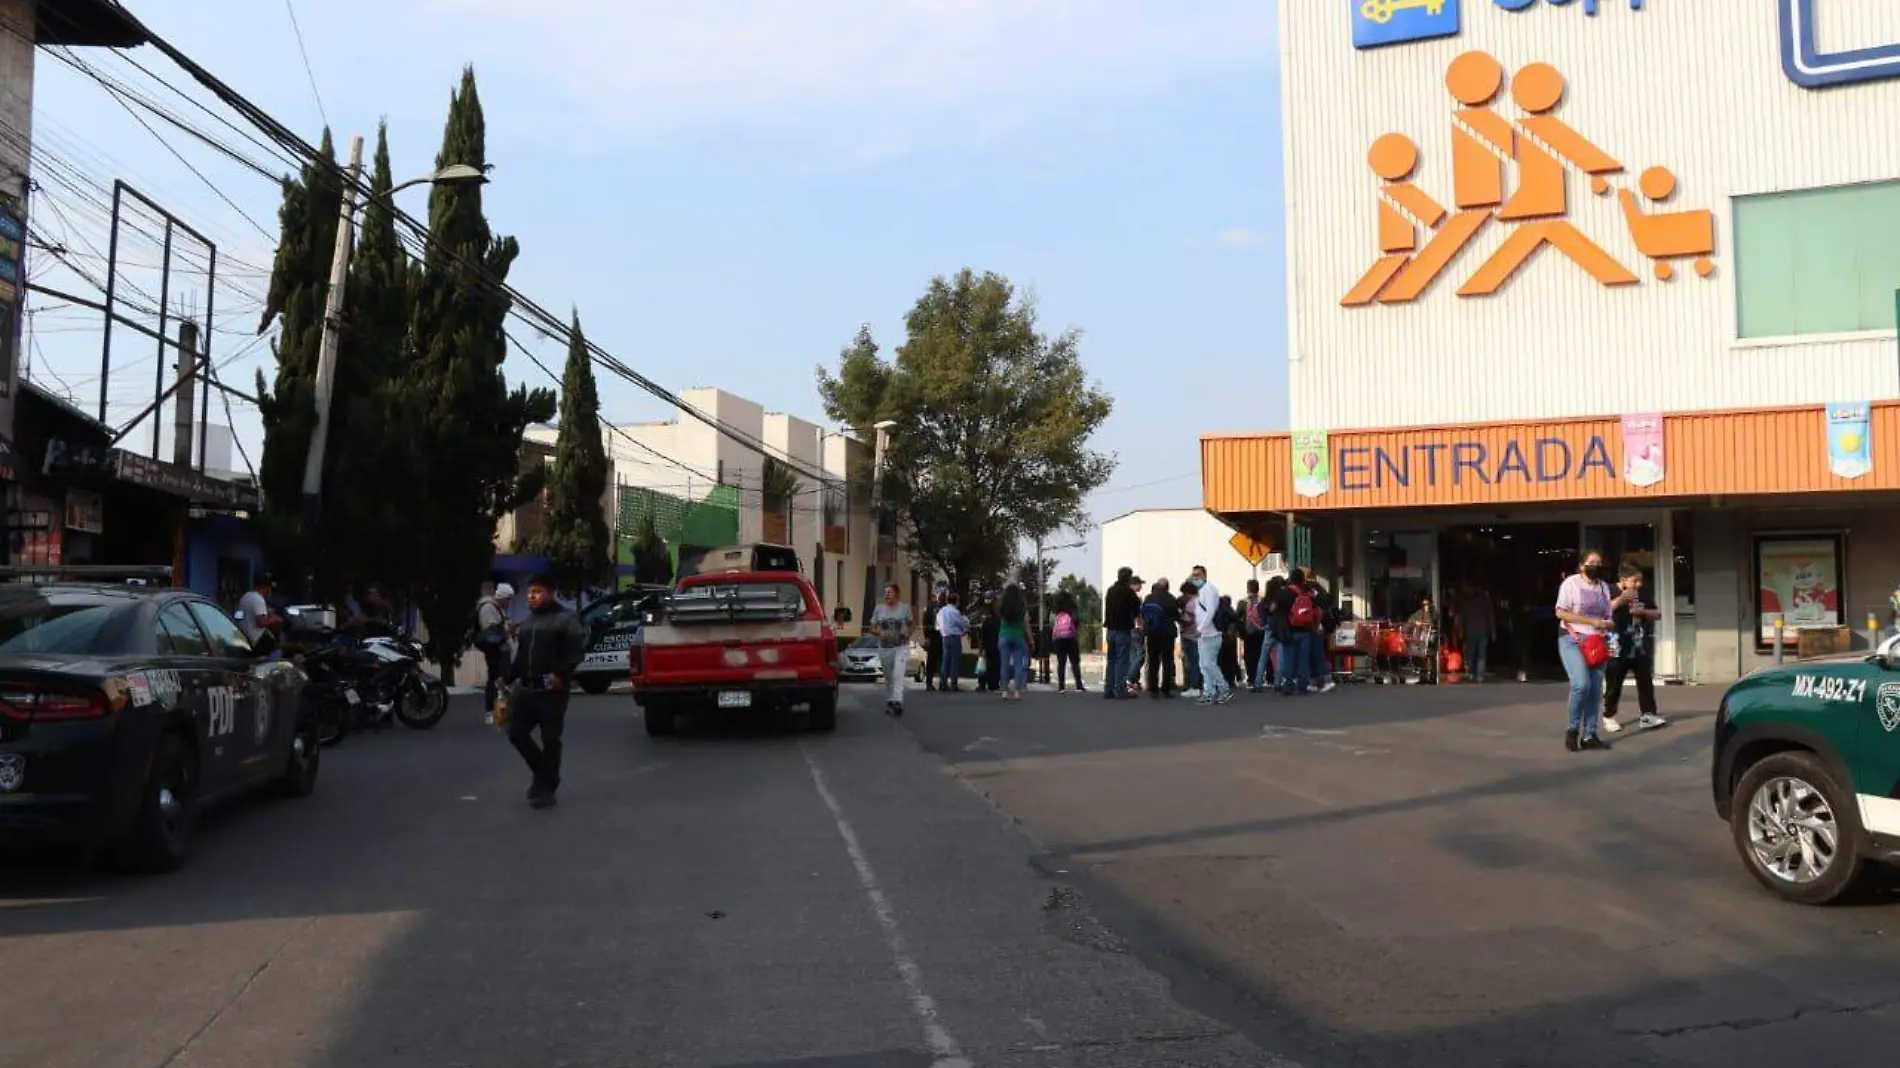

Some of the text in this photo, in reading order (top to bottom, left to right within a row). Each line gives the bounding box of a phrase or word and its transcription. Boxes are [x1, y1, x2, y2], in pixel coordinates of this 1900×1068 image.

[1338, 435, 1616, 489] ENTRADA
[603, 633, 636, 643] ESCUD
[1791, 674, 1867, 703] MX-492-Z1
[207, 686, 235, 738] PDI
